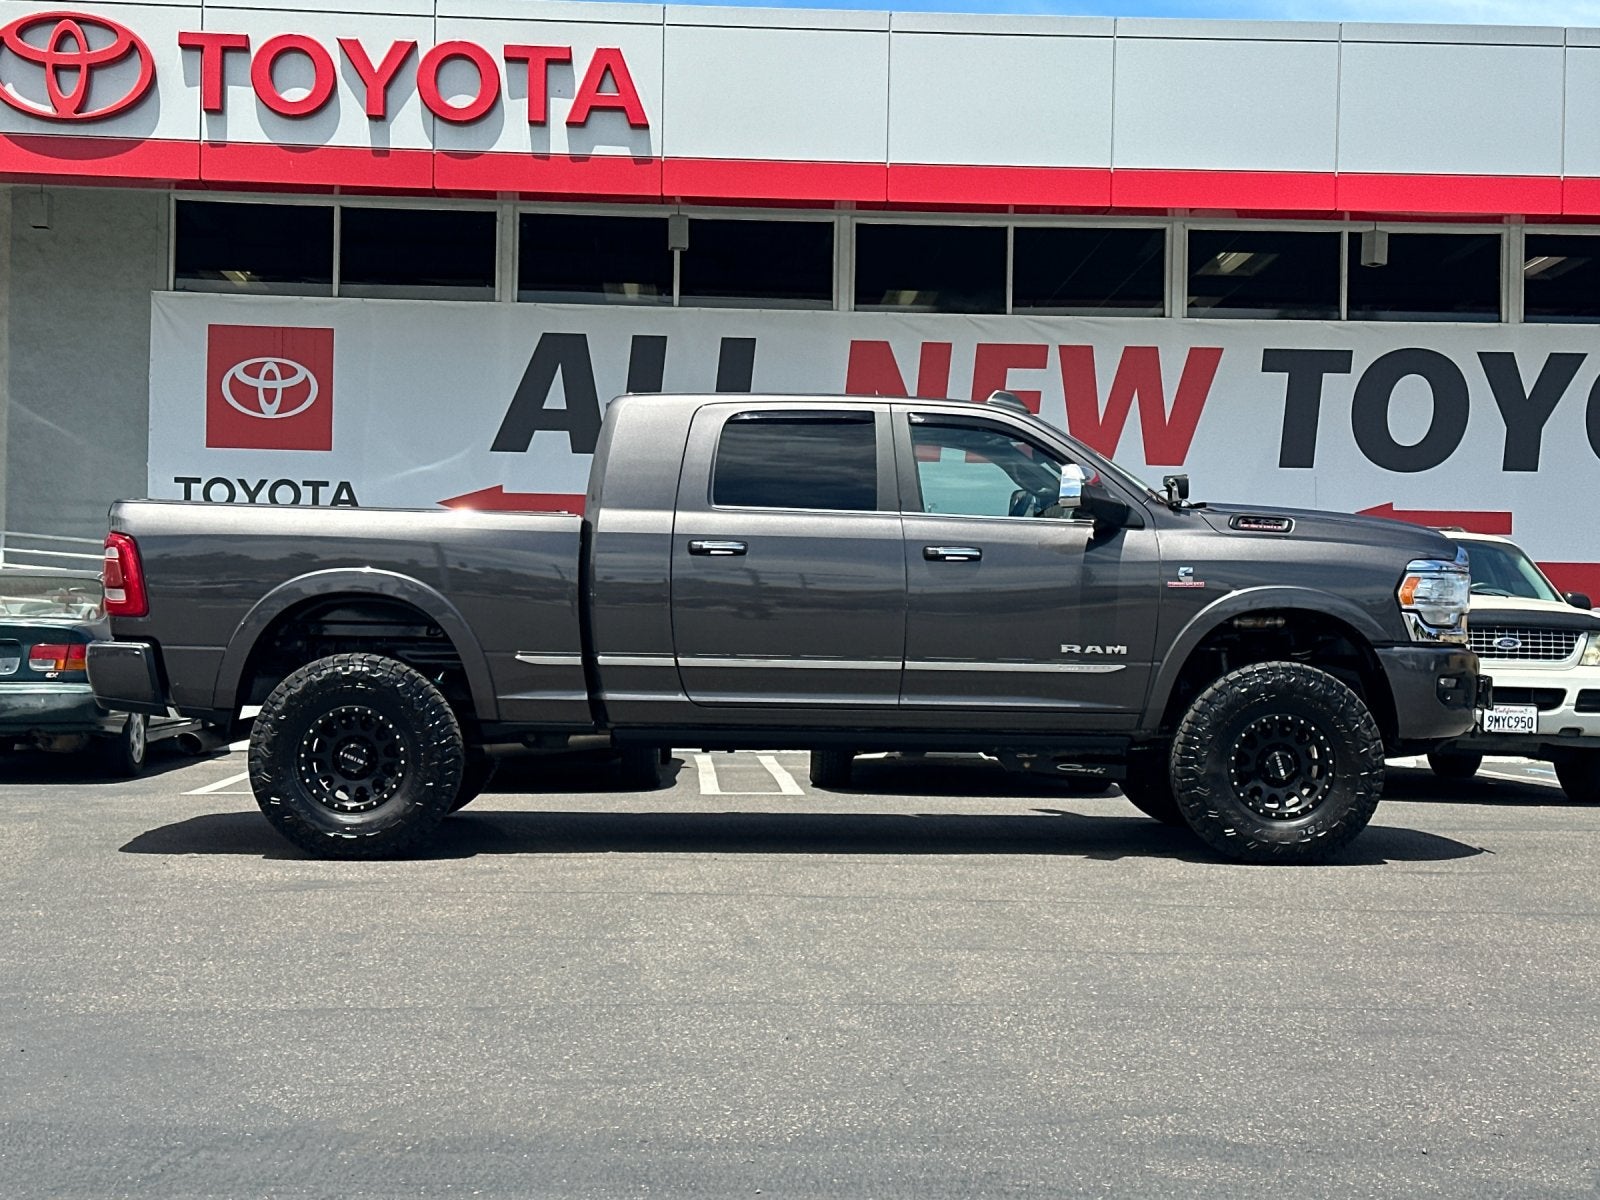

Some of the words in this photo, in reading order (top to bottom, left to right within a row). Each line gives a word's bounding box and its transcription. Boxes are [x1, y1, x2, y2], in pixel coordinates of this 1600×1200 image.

[178, 32, 649, 128] TOYOTA
[1261, 347, 1600, 473] TOY
[173, 476, 359, 507] TOYOTA
[1060, 644, 1128, 655] RAM
[1487, 715, 1534, 729] 9MYC950
